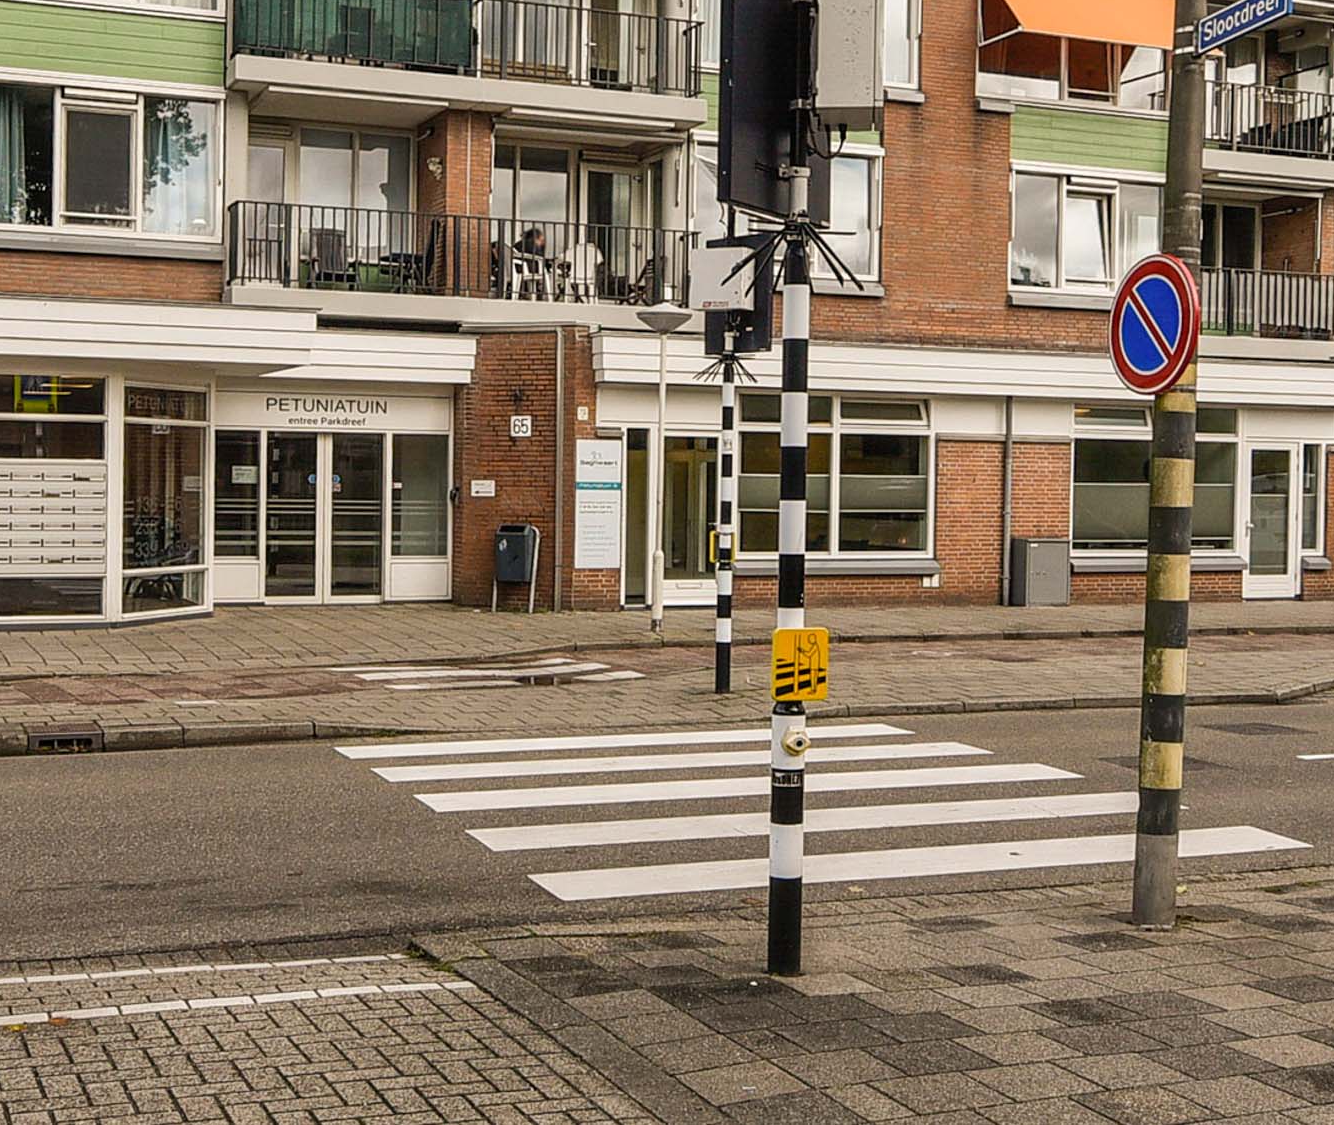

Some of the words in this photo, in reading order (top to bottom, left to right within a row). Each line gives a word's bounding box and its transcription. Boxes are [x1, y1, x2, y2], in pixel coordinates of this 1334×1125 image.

[266, 397, 387, 414] PETUNIATUIN
[288, 417, 318, 425] entree
[320, 417, 366, 426] Parkdreef
[512, 418, 529, 435] 65
